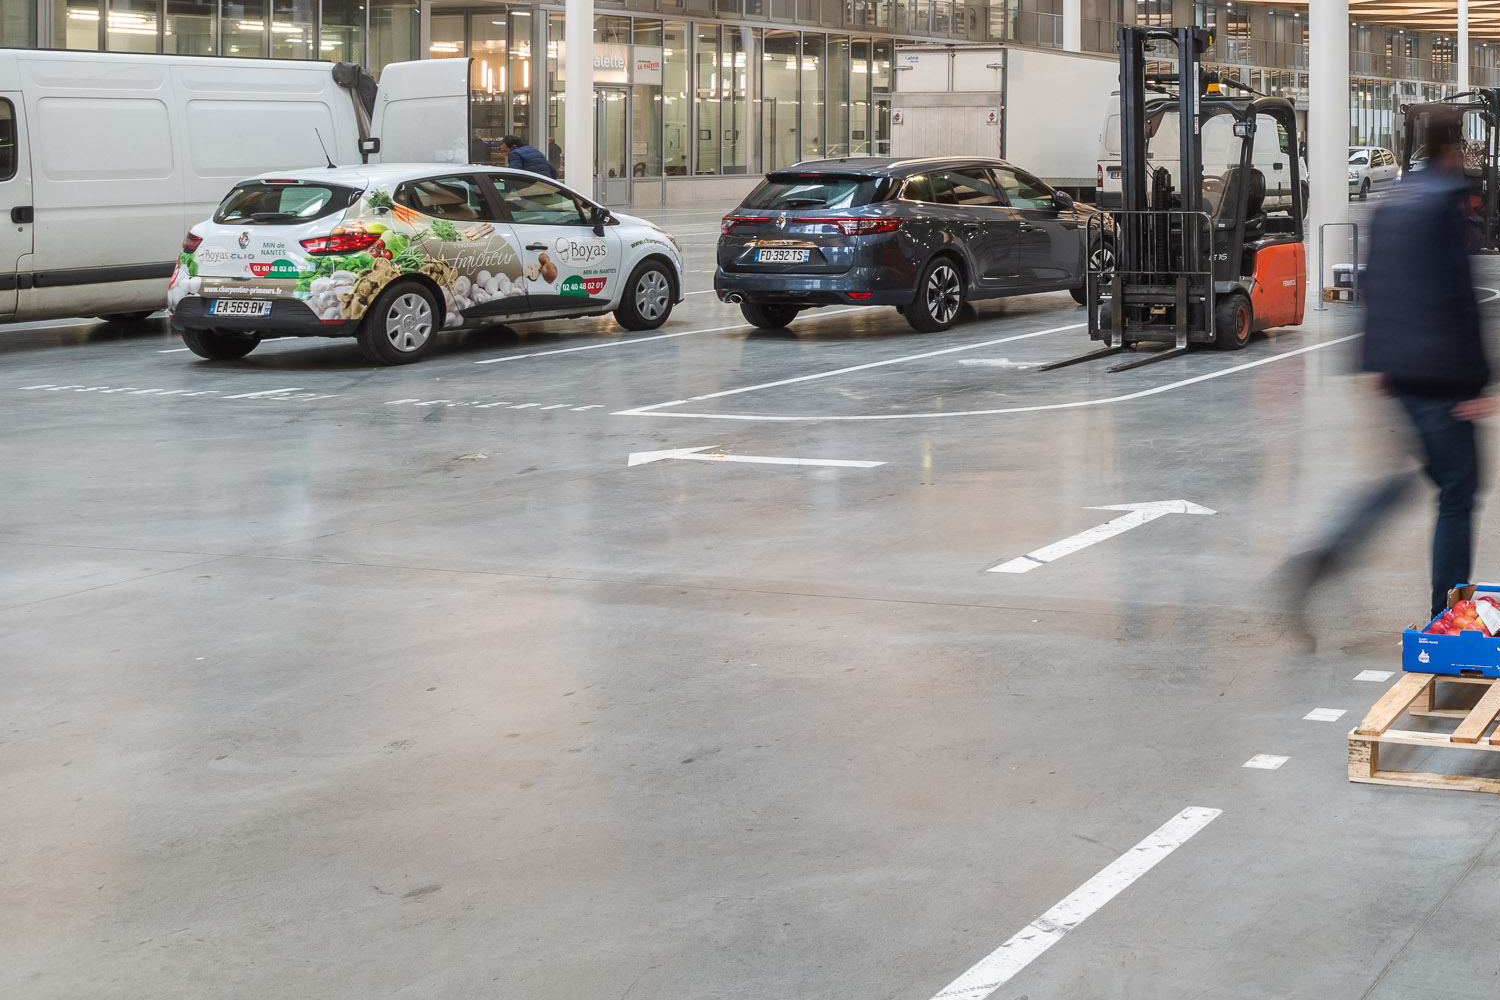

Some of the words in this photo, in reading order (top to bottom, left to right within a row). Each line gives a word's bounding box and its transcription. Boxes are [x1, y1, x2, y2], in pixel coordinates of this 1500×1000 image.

[594, 53, 624, 68] alette
[570, 241, 607, 262] Boyas
[760, 250, 803, 260] FD-392-TS
[204, 285, 283, 295] www.charpentier-primeurs.fr
[596, 281, 603, 289] 01
[216, 301, 264, 314] EA-569-BW
